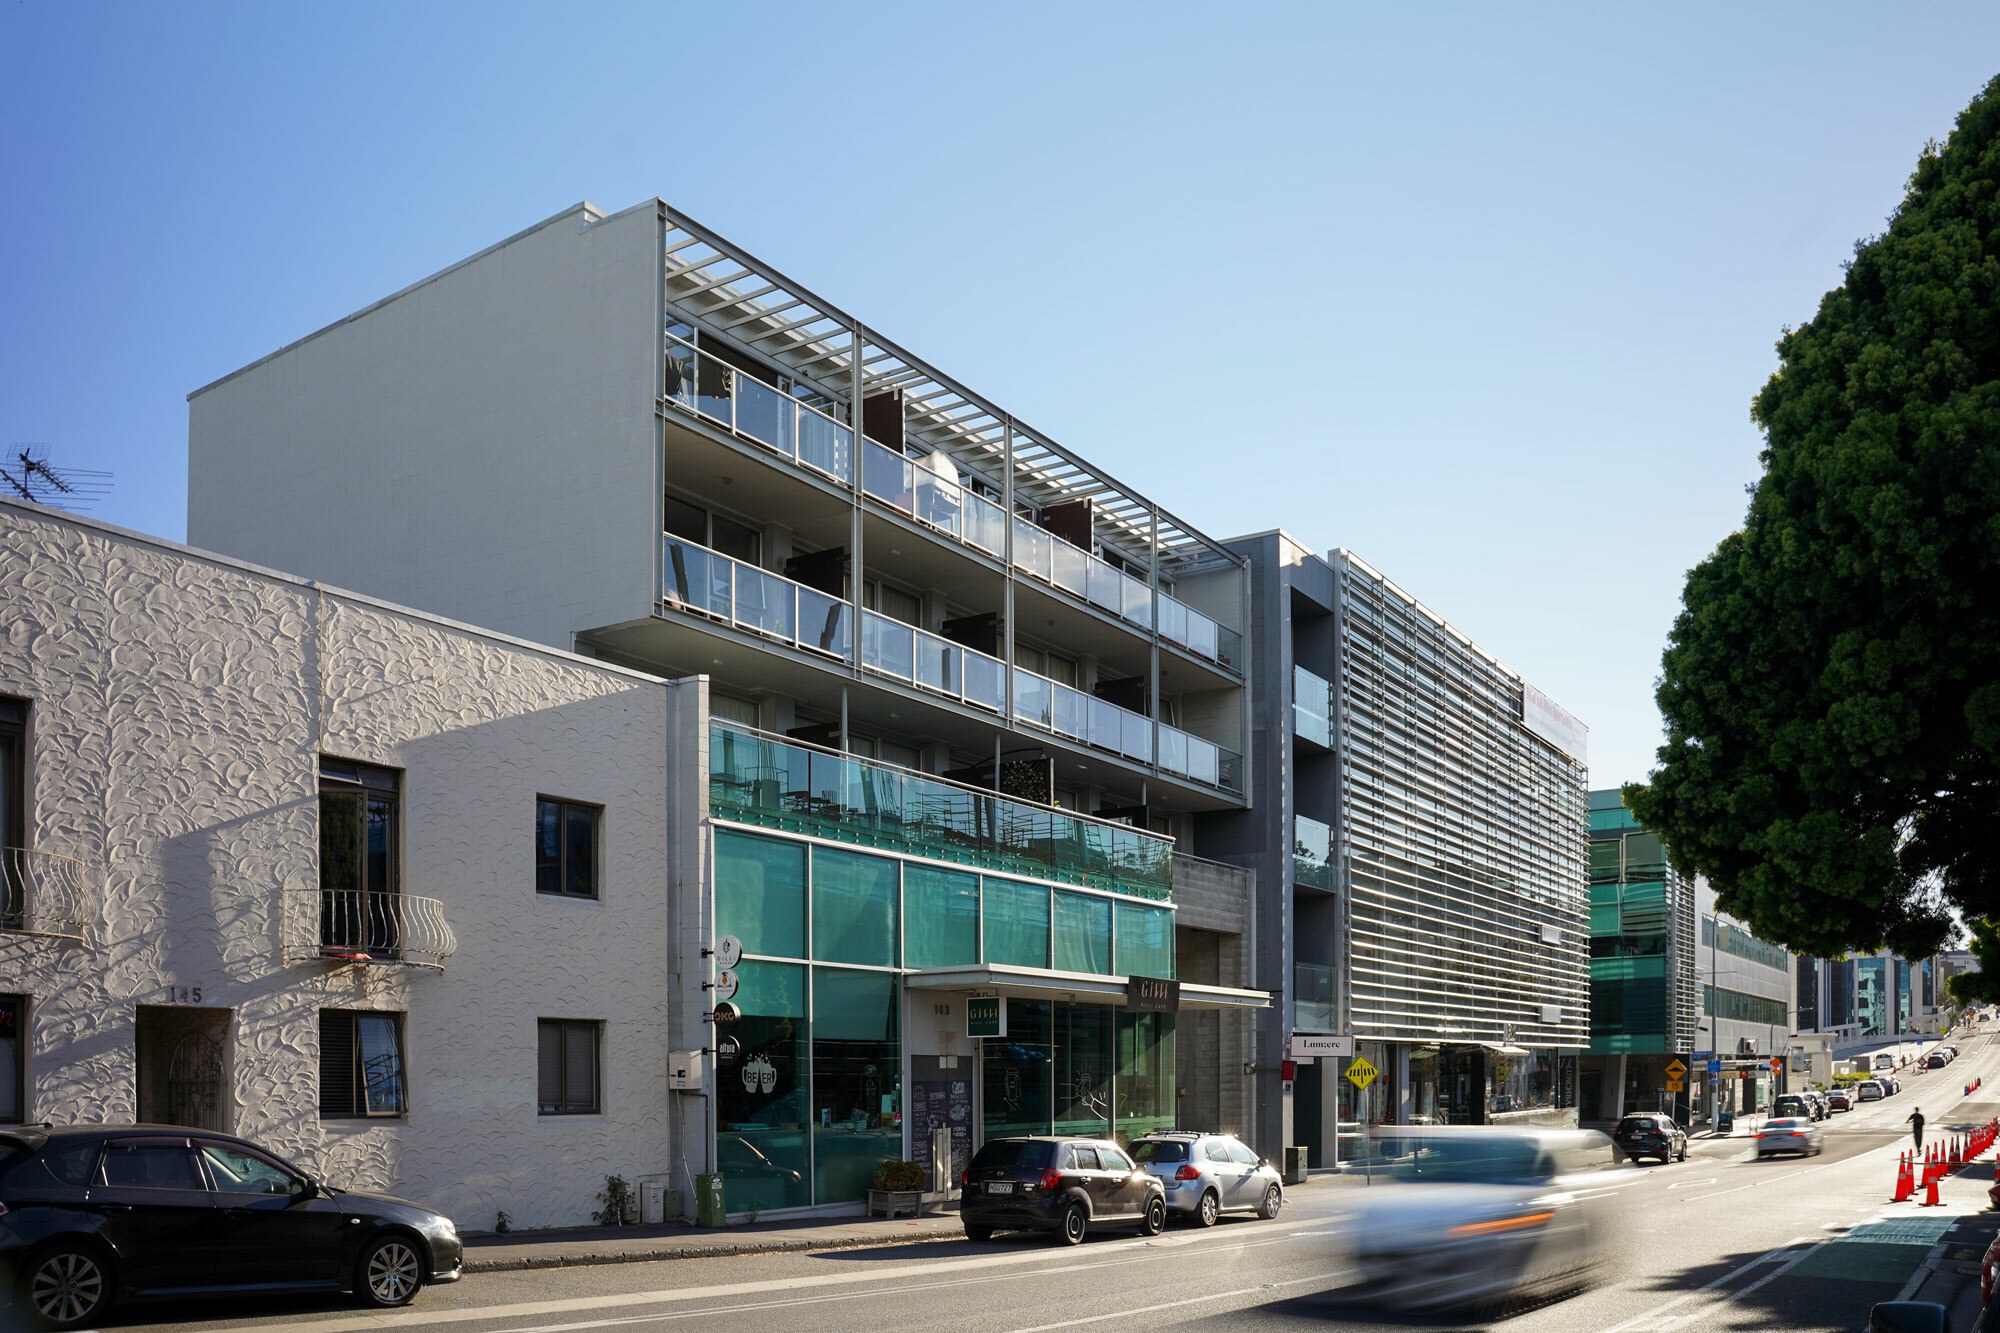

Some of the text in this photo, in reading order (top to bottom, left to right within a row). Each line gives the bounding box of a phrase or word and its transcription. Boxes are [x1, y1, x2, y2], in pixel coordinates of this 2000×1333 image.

[170, 986, 202, 1003] 145
[934, 1004, 950, 1016] 143
[719, 1043, 736, 1054] altura
[747, 1072, 772, 1084] BEER
[1565, 1064, 1573, 1107] LUNCHBA
